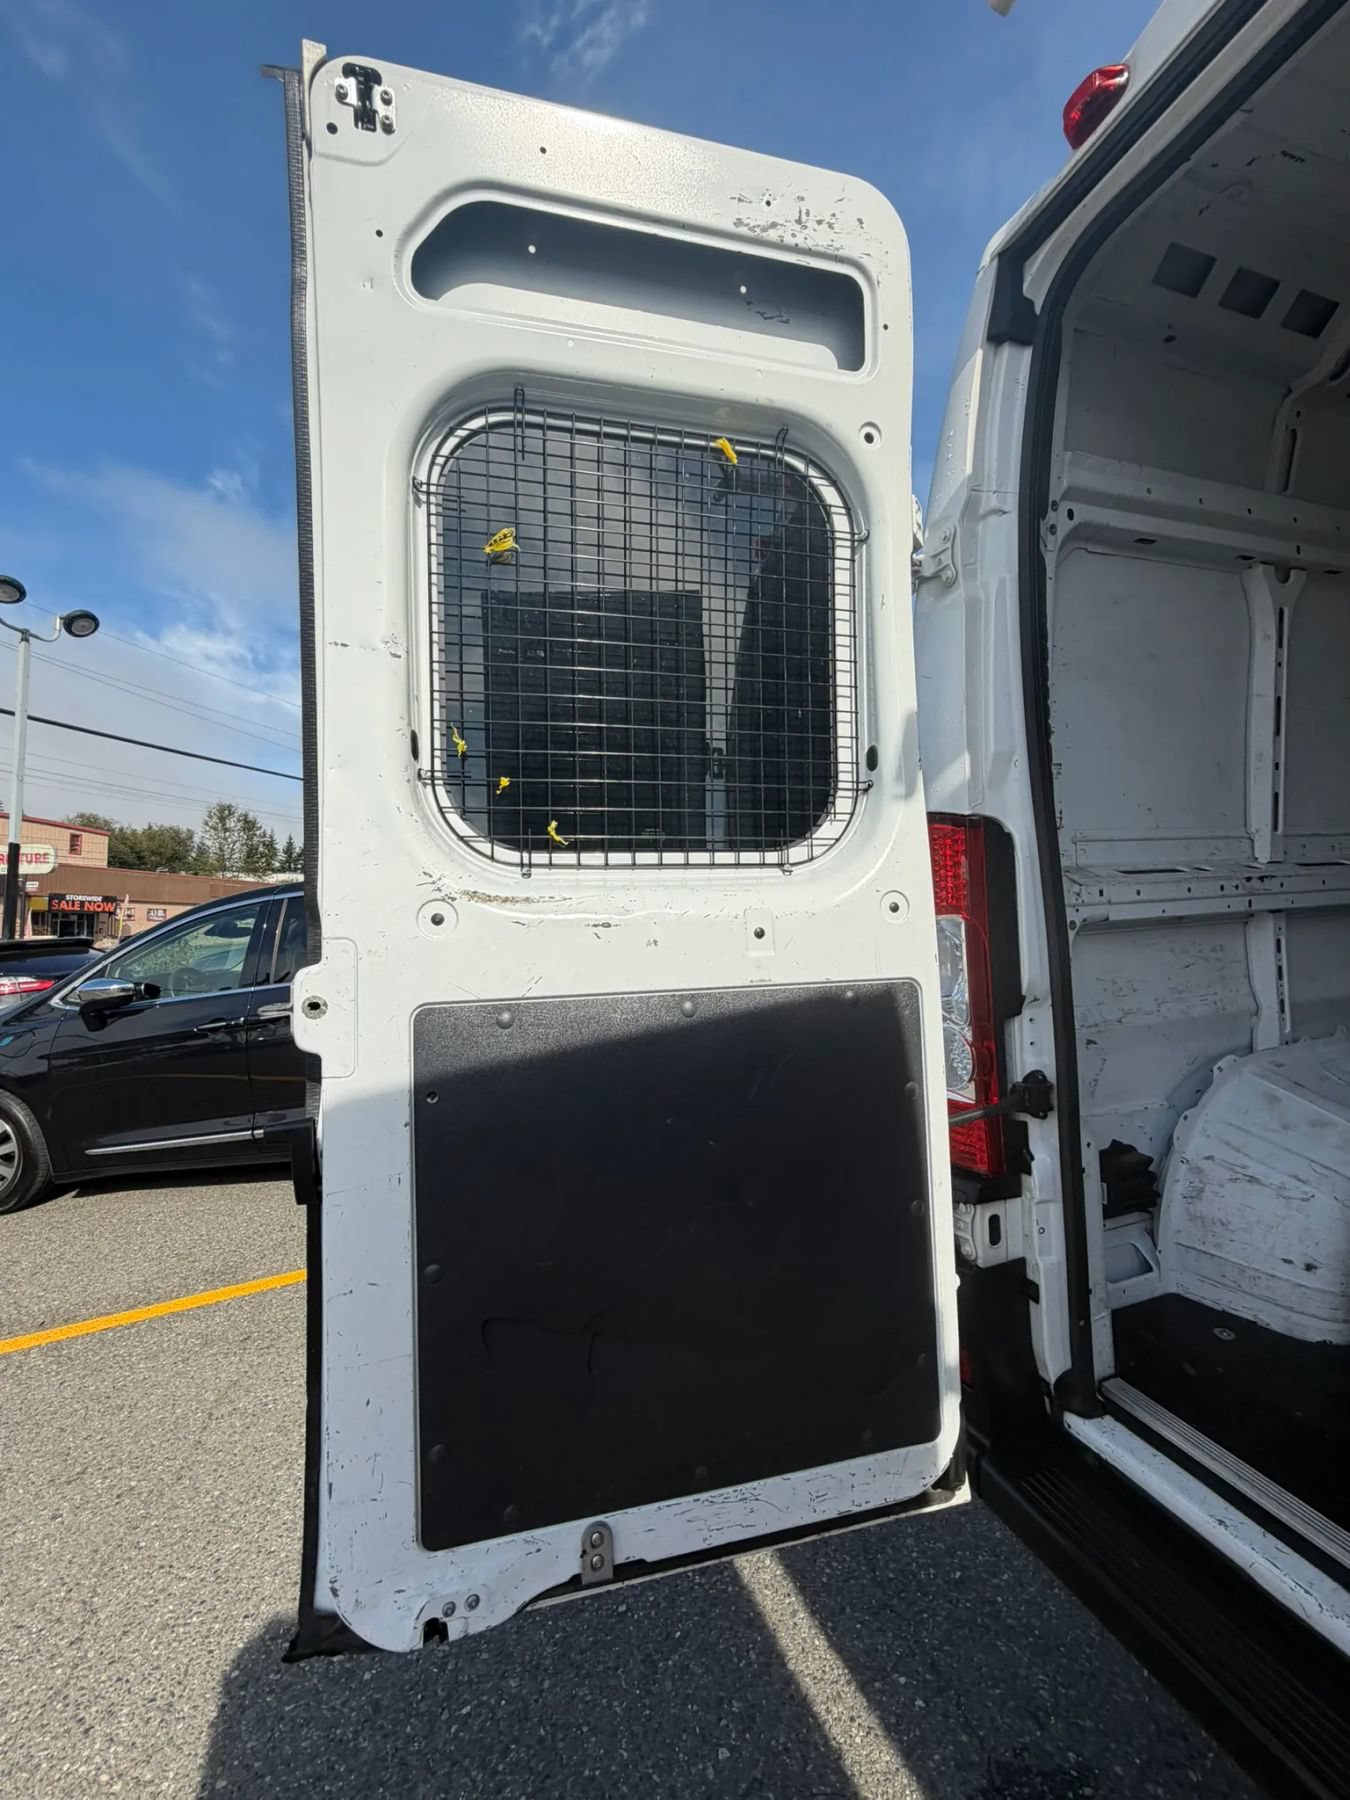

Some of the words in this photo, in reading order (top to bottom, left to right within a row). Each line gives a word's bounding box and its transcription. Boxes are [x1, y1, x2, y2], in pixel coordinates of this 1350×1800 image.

[0, 853, 50, 864] RTURE
[66, 894, 103, 902] STOREWIDE
[51, 899, 81, 911] SALE
[84, 901, 116, 912] NOW
